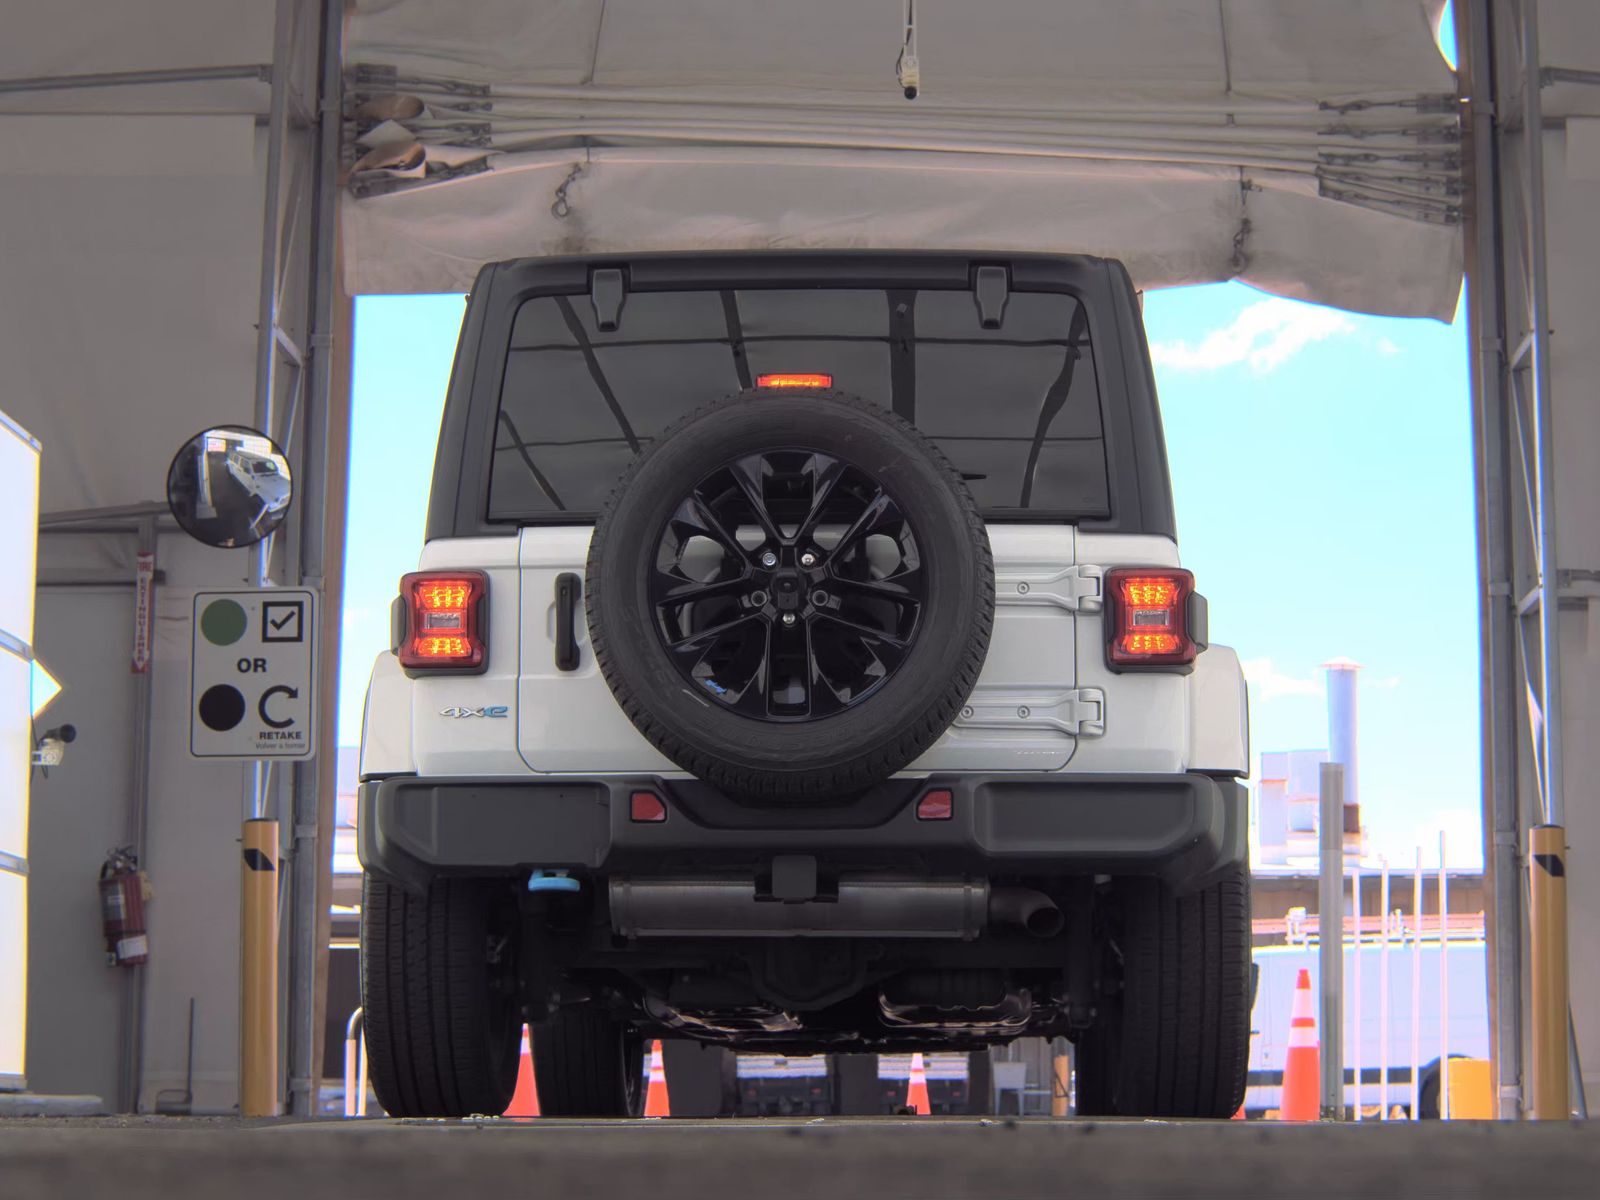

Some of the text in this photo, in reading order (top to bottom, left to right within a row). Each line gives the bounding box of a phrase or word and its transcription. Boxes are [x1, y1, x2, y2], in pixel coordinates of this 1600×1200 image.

[137, 577, 147, 662] EXTINGUISHER
[236, 657, 267, 673] OR
[258, 731, 302, 740] RETAKE
[255, 741, 277, 749] Volver
